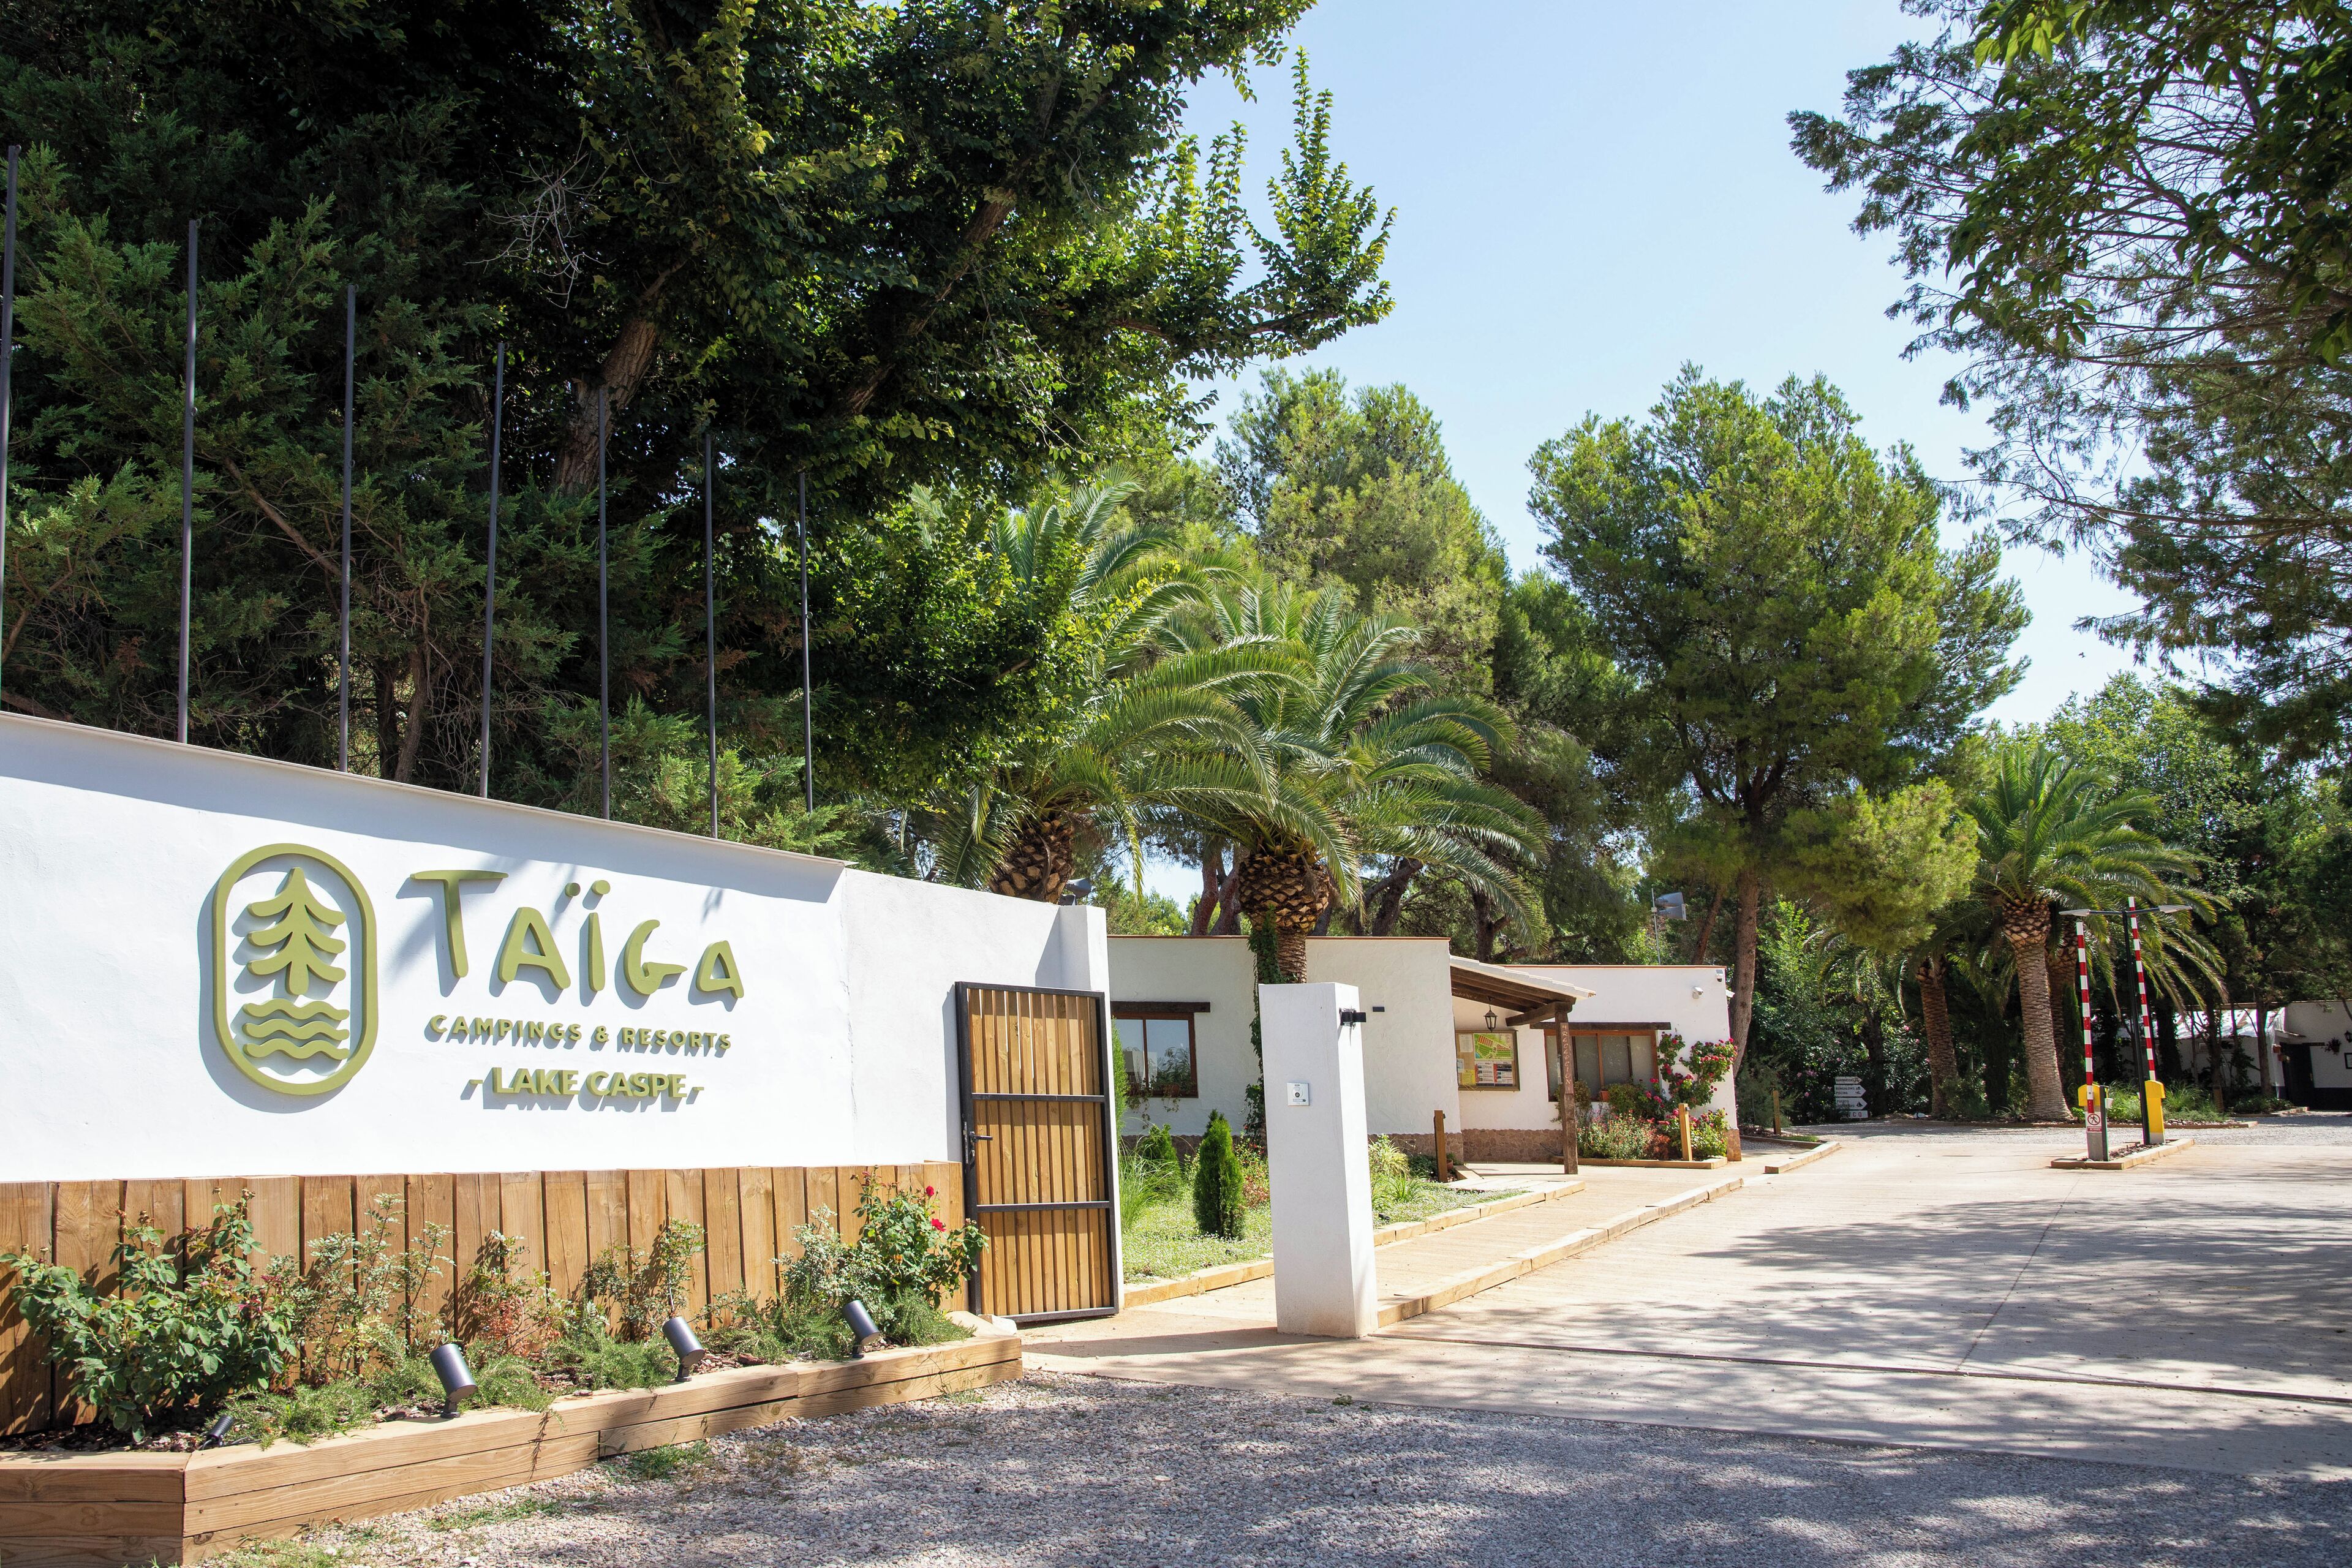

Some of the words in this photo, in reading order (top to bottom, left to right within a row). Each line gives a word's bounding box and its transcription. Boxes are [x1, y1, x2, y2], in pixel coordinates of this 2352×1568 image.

[430, 1014, 582, 1041] CAMPINGS
[595, 1025, 609, 1042] &
[621, 1027, 731, 1049] RESORTS
